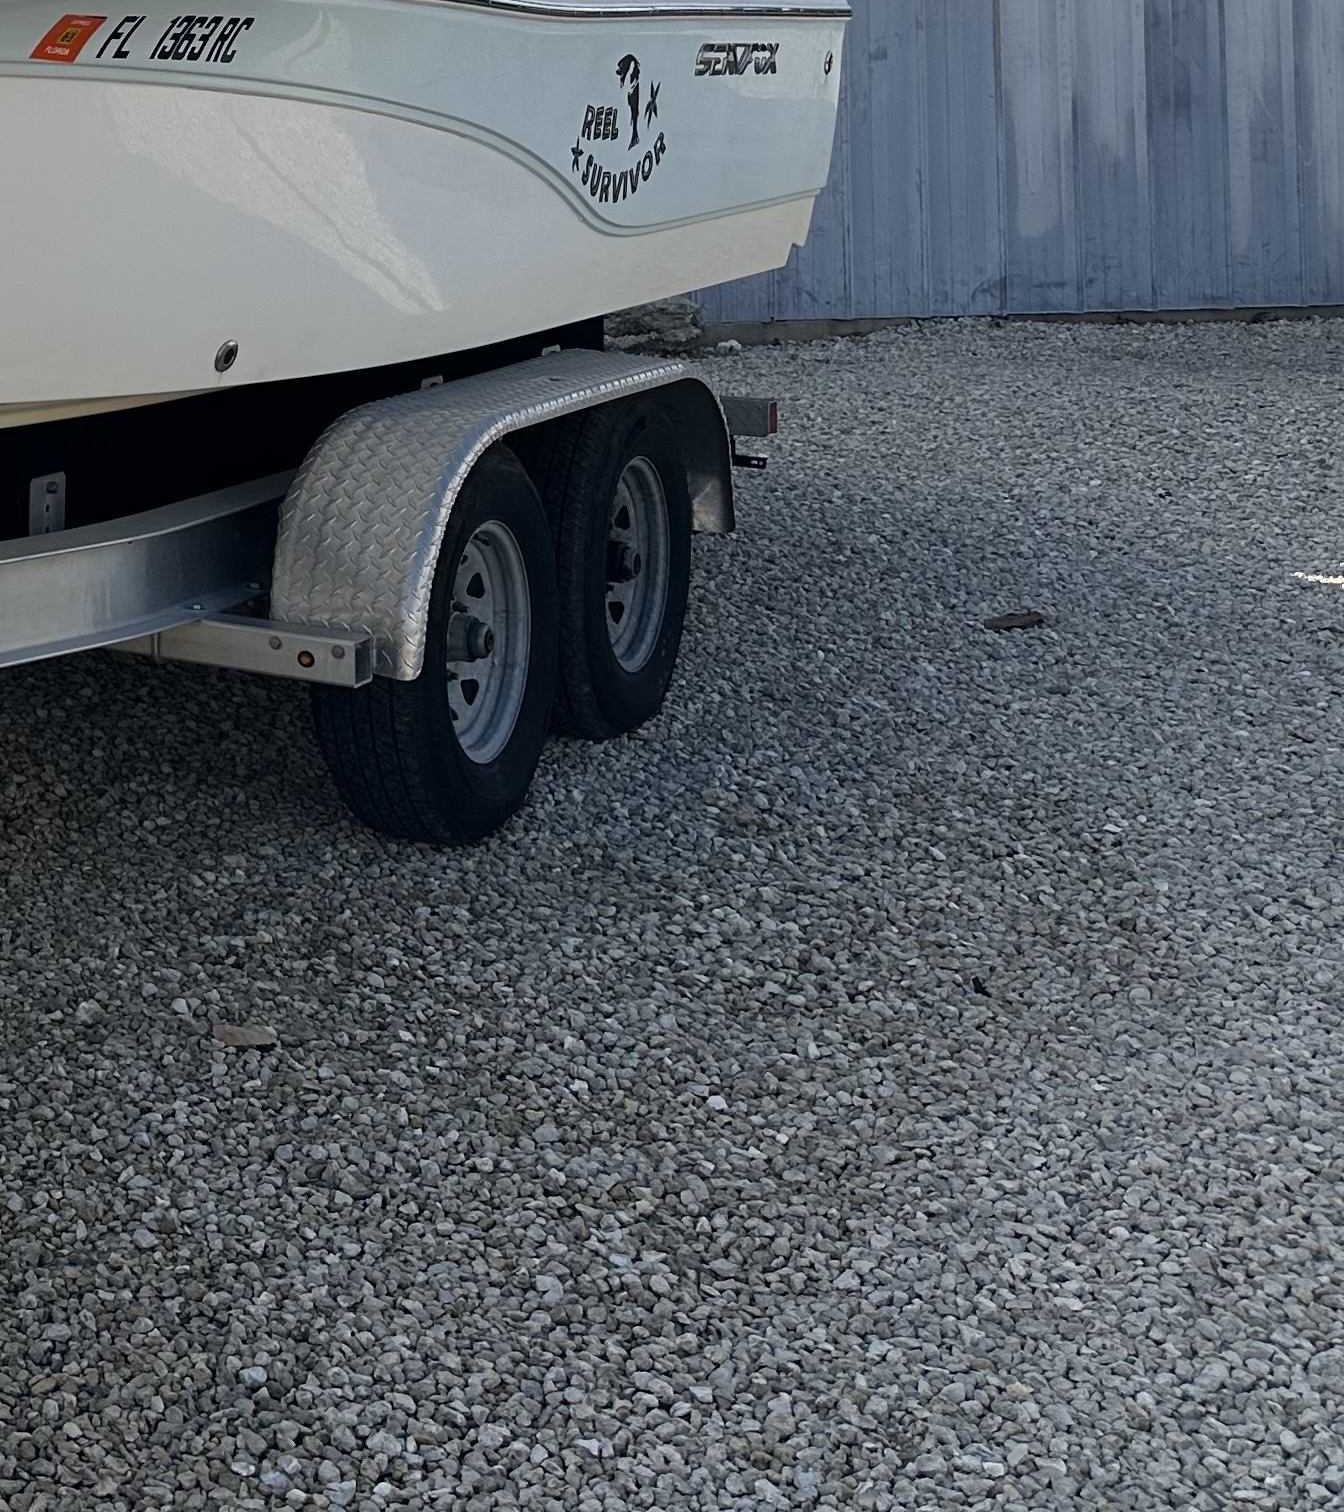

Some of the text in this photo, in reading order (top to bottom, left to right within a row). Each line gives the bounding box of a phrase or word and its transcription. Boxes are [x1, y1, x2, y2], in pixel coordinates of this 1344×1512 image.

[95, 15, 255, 64] FL 1363 RC
[581, 104, 619, 141] REEL
[581, 131, 666, 204] SURVIVOR
